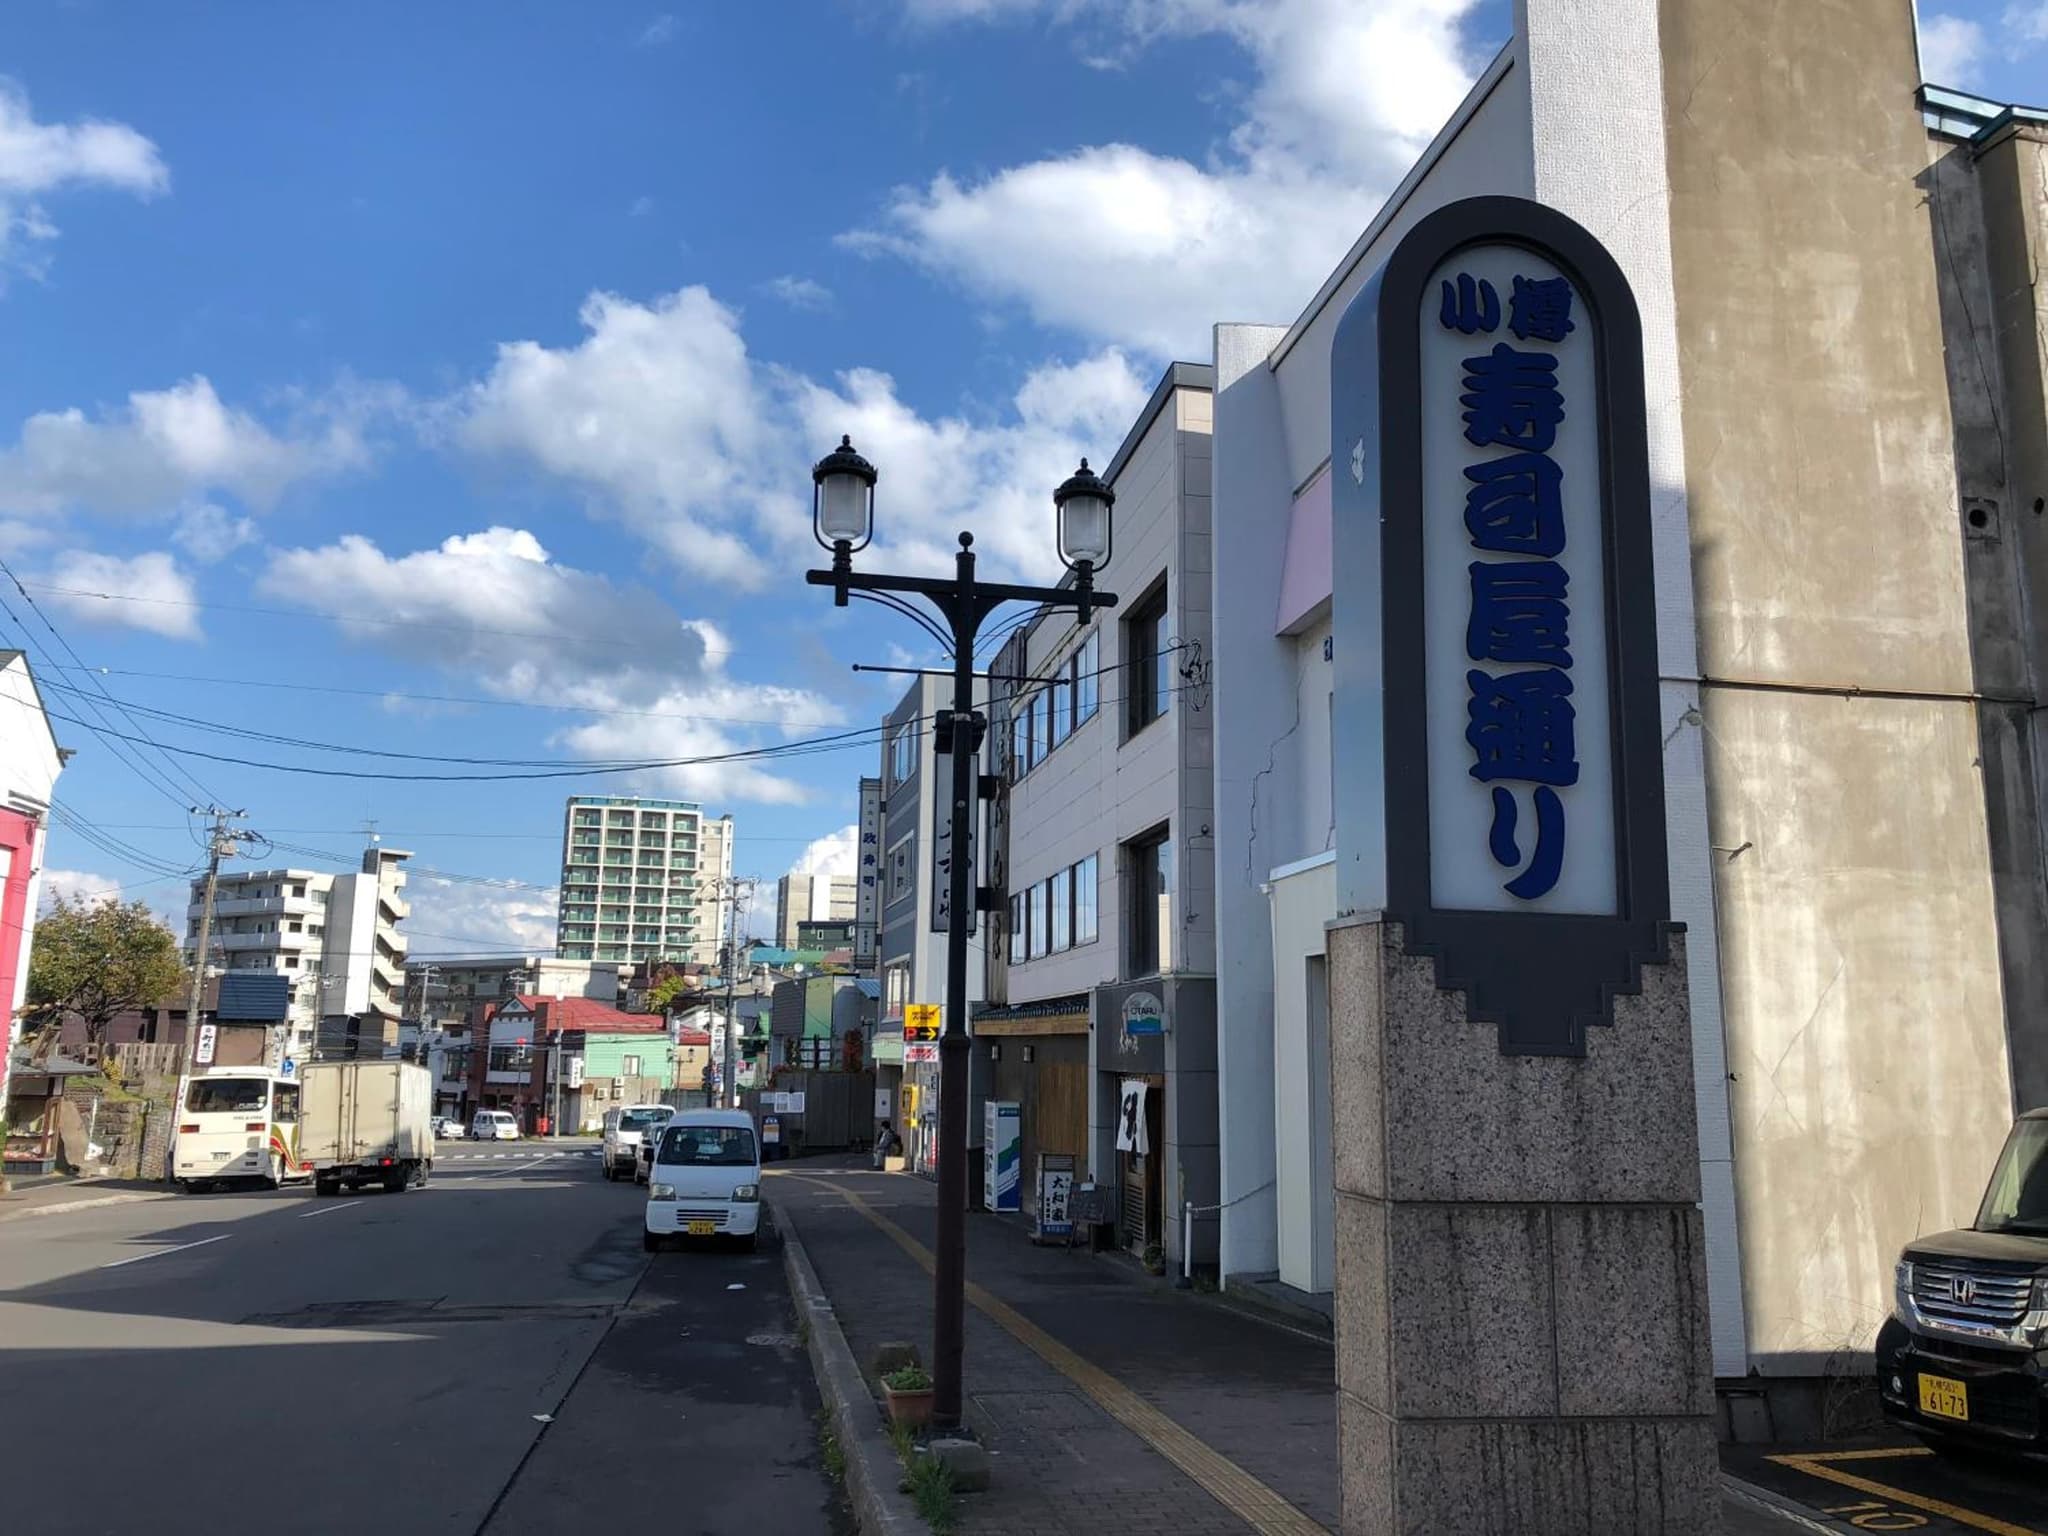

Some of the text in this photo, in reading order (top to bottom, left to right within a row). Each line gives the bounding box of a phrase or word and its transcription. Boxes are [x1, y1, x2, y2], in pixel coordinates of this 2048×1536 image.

[1439, 272, 1576, 344] 小樽
[1458, 343, 1580, 901] 寿司屋通り
[862, 831, 877, 888] 政寿司
[905, 1028, 918, 1041] P
[1130, 1006, 1158, 1016] OTARU
[1051, 1175, 1065, 1222] 大和家
[1930, 1391, 1965, 1417] 61-73
